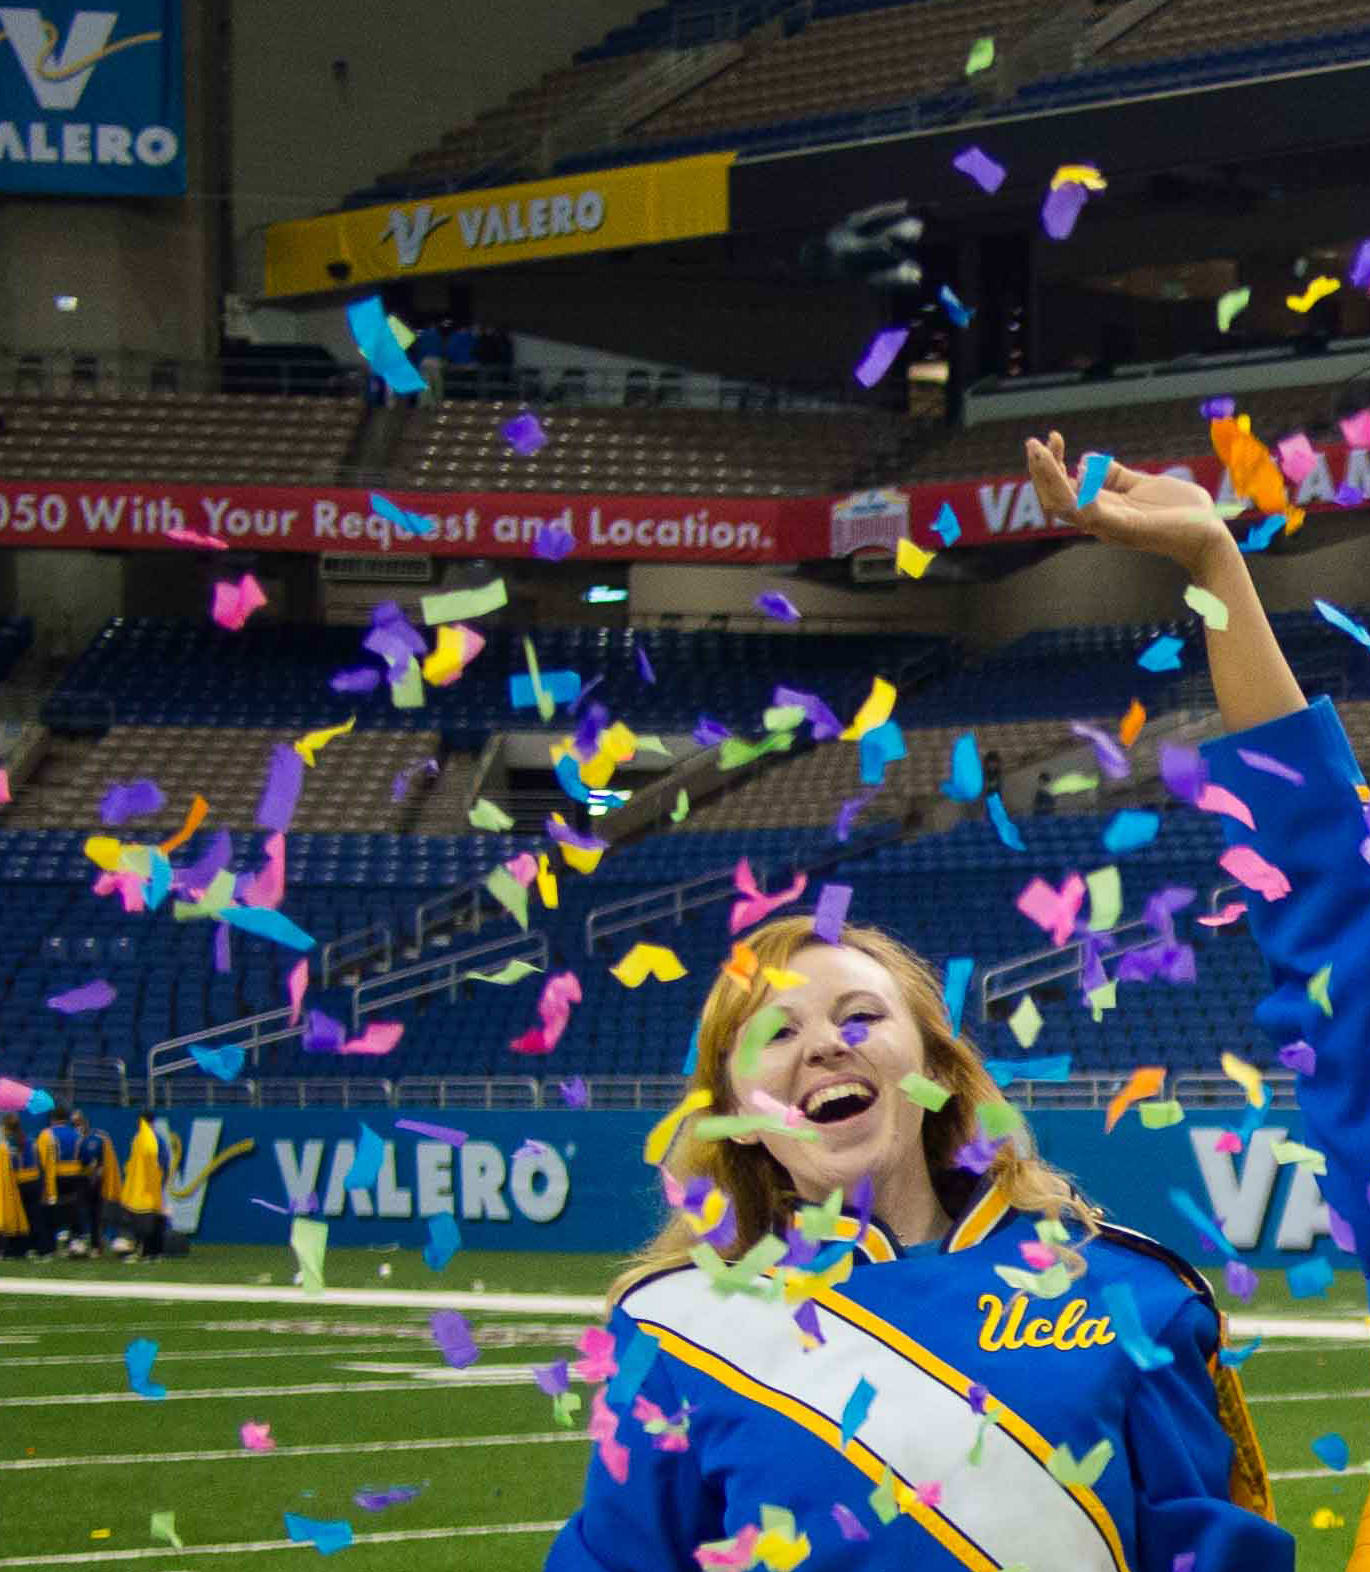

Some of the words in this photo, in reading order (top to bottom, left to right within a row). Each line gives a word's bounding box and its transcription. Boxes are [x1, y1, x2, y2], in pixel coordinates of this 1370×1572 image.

[457, 190, 603, 248] VALERO
[80, 495, 186, 534] With
[201, 497, 299, 537] Your
[589, 508, 775, 550] Location.
[274, 1136, 571, 1224] VALERO
[977, 1293, 1116, 1352] Ucla
